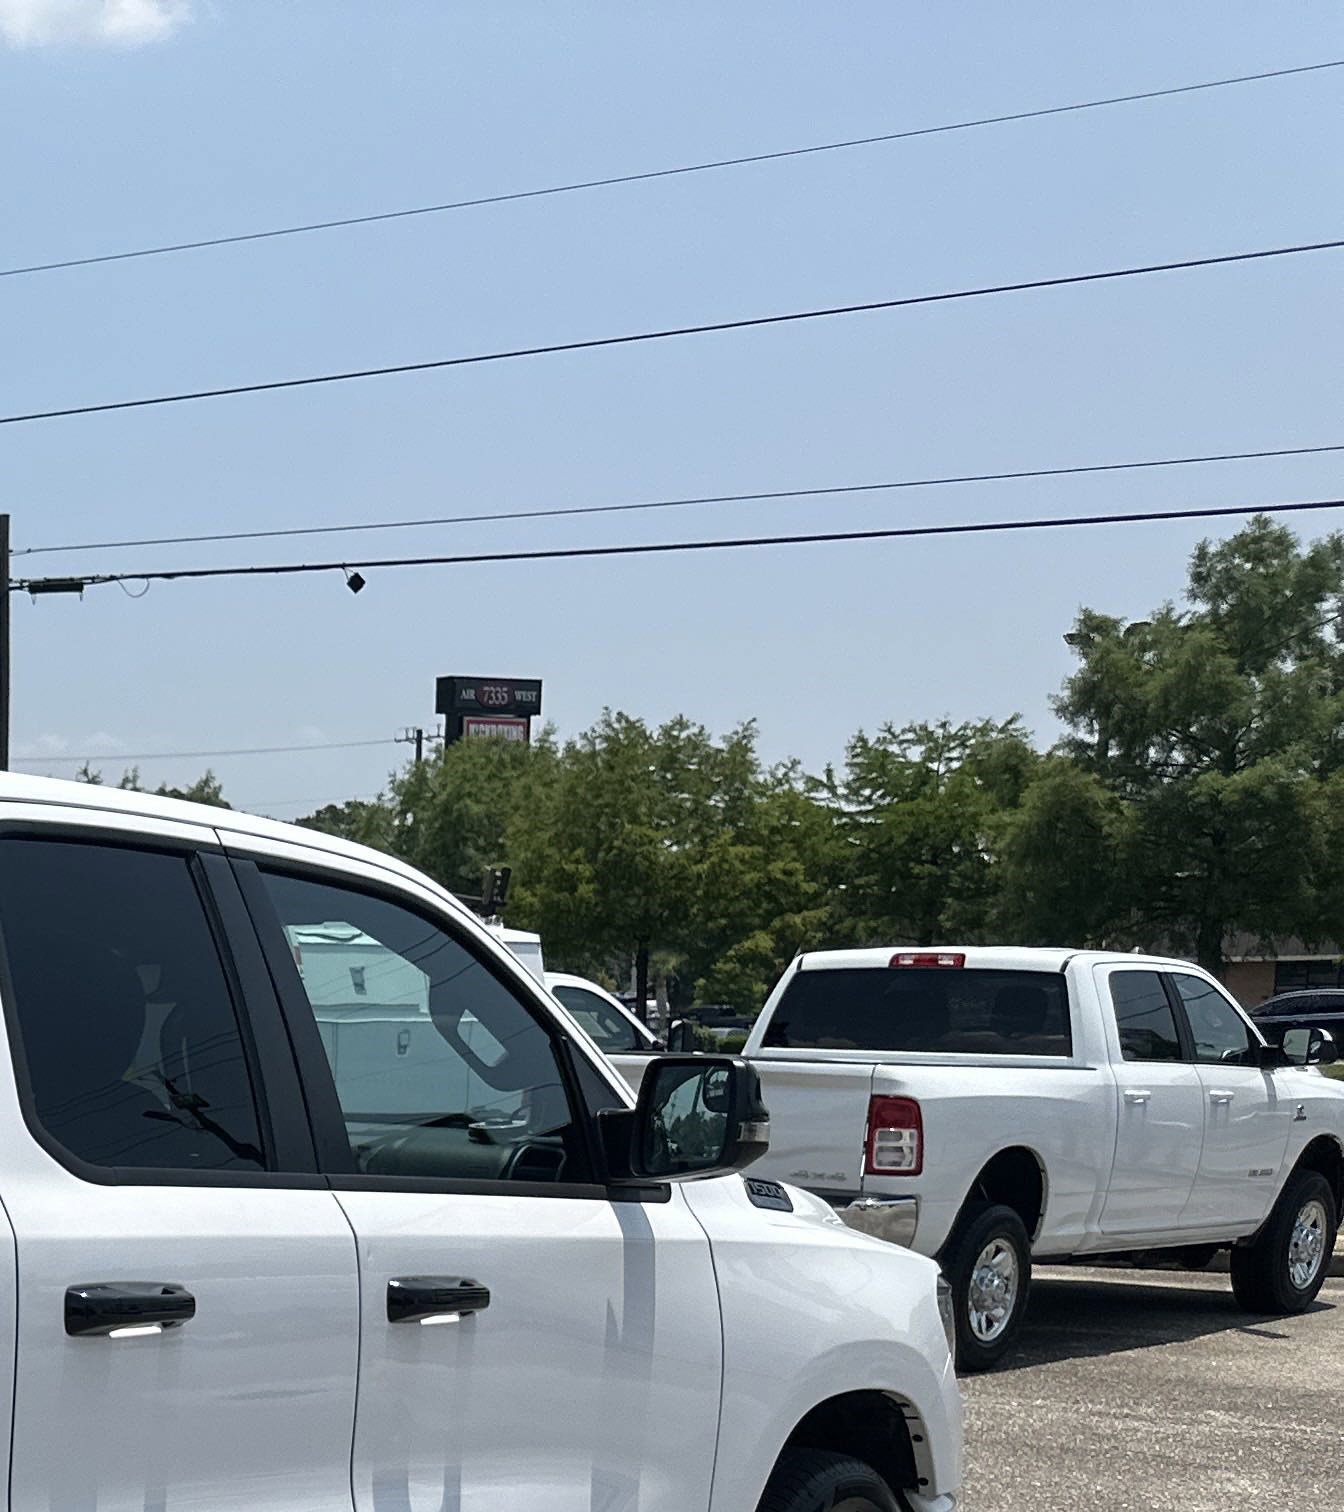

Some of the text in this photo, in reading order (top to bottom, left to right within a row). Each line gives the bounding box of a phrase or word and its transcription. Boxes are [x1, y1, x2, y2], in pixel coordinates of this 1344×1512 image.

[461, 686, 537, 705] AIR 7335 WEST
[752, 1182, 782, 1199] 1500
